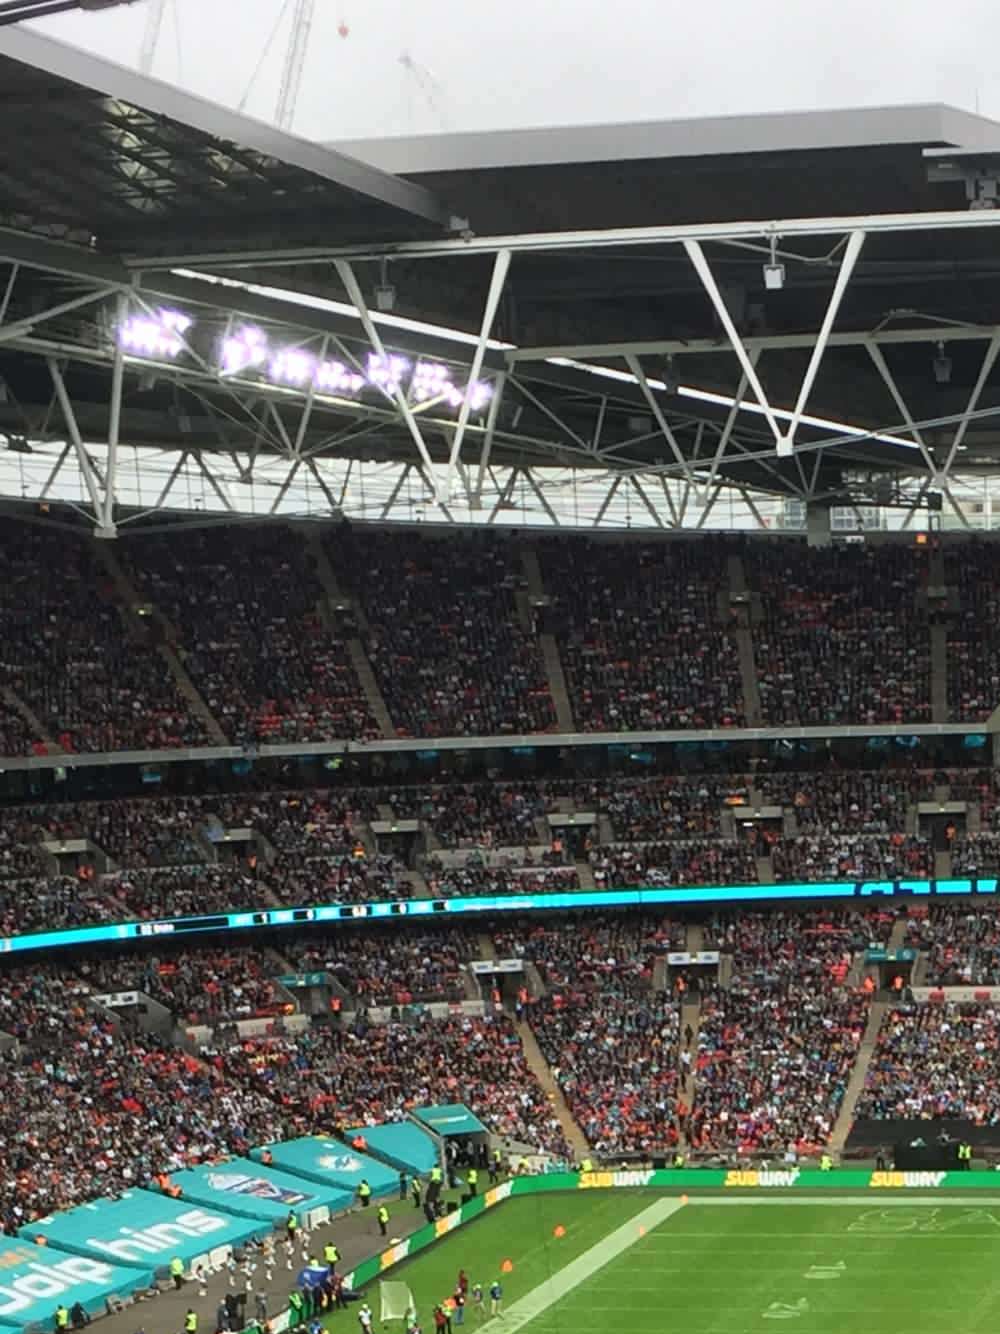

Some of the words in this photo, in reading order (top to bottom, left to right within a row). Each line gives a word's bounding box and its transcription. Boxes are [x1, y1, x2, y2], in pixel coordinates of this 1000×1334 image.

[577, 1170, 655, 1188] SUBWAY
[724, 1170, 801, 1187] SUBWAY
[869, 1170, 947, 1187] SUBWAY
